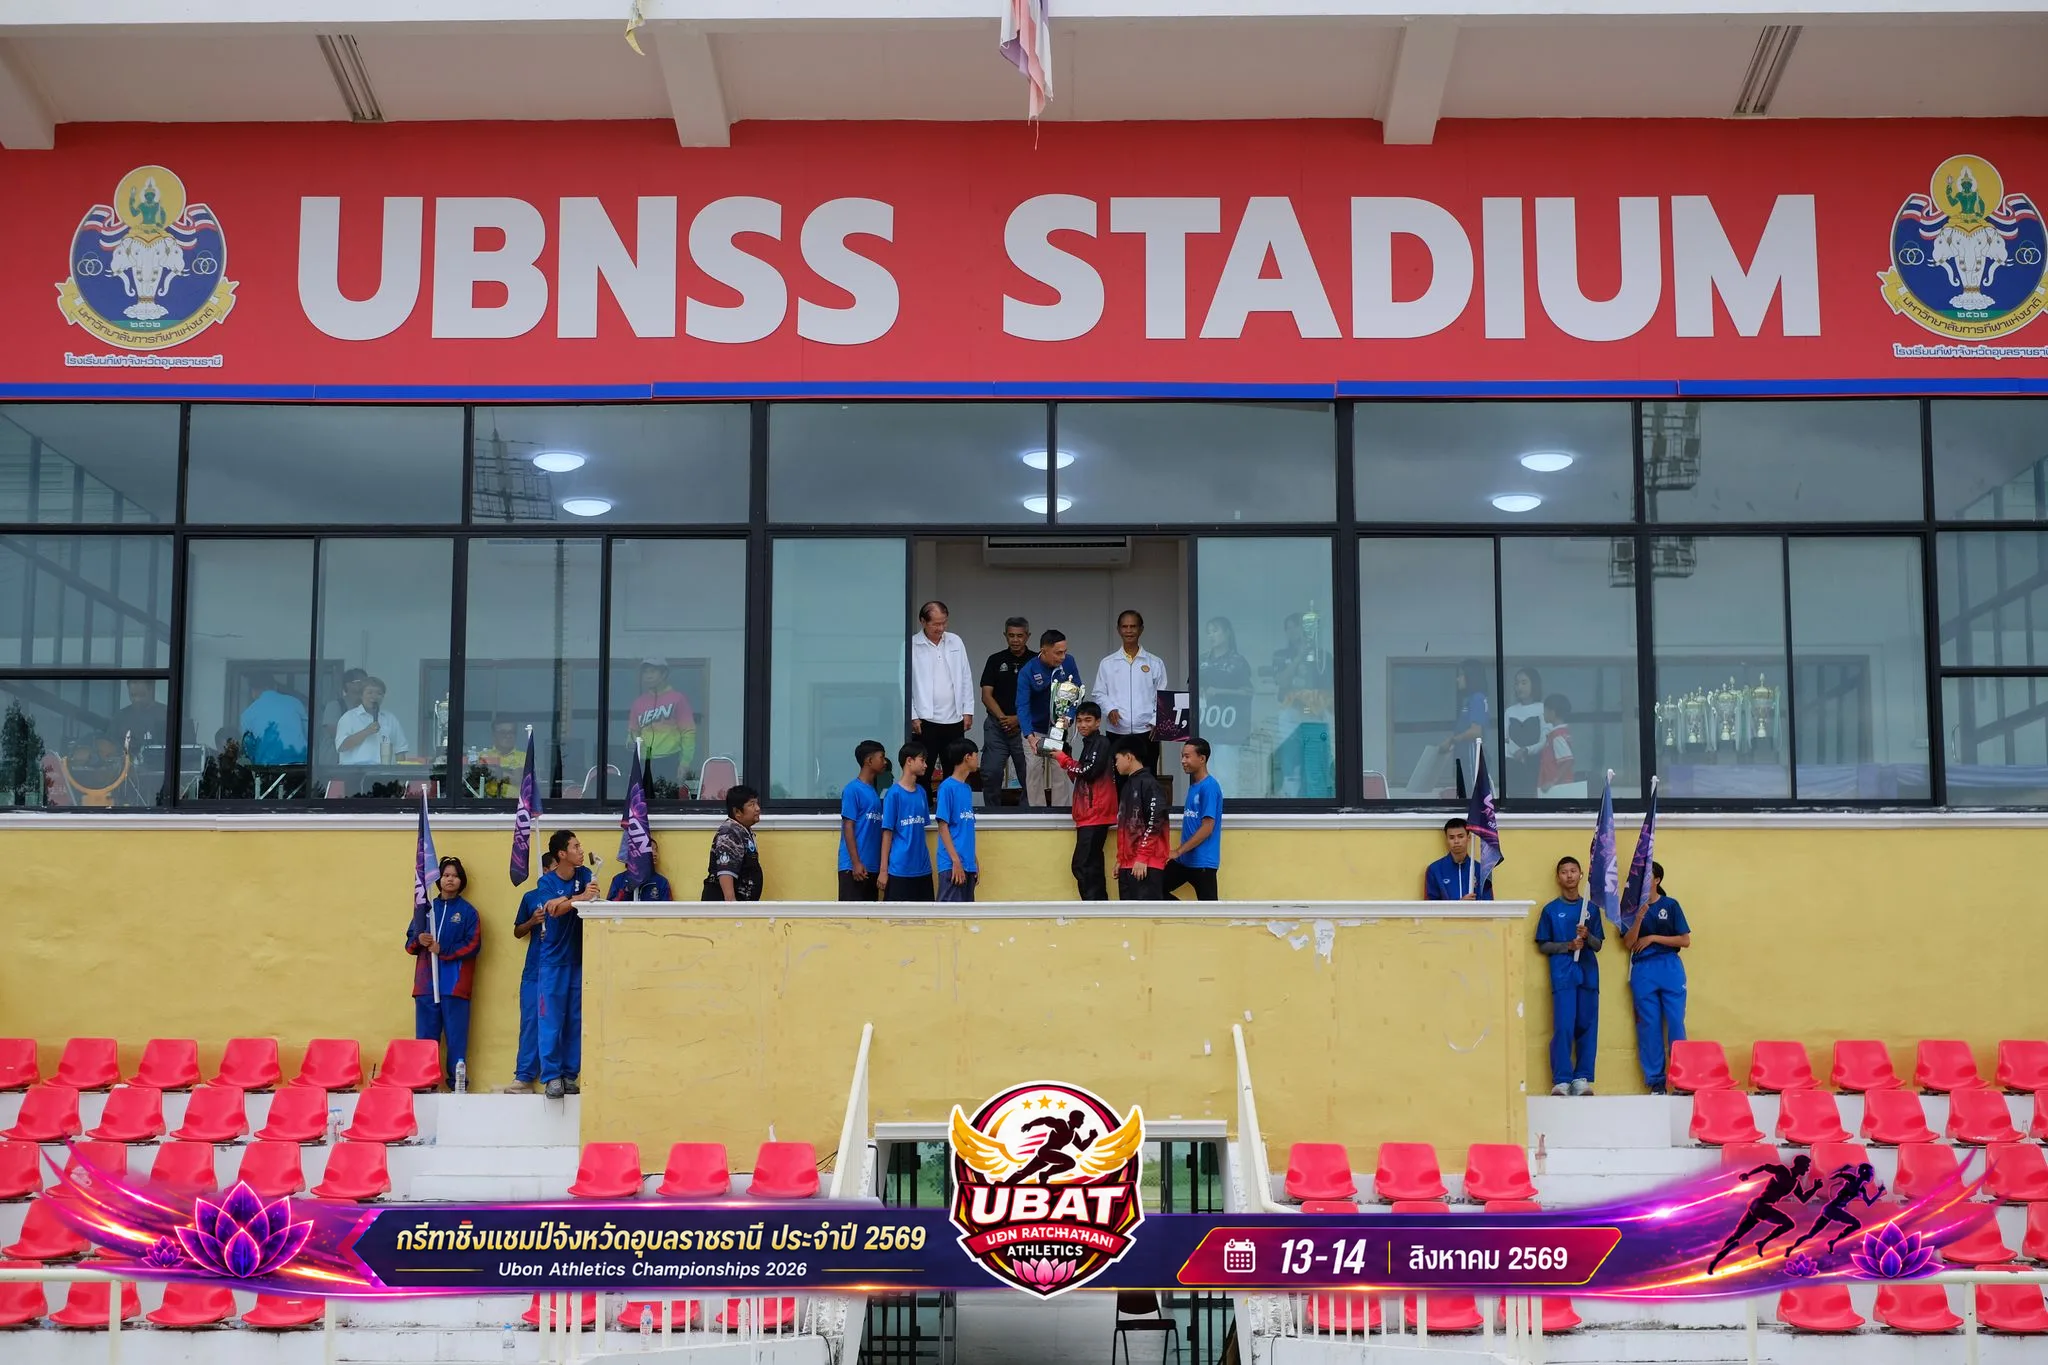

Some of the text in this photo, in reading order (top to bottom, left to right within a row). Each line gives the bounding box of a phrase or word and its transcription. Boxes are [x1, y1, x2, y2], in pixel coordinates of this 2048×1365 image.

[297, 193, 1821, 345] UBNSS STADIUM
[77, 306, 216, 345] มหาวิทยาลัยการกีฬาแห่งชาติ
[1901, 297, 2042, 334] มหาวิทยาลัยการกีฬาแห่งชาติ
[66, 354, 221, 368] โรงเรียนกีฬาจังหวัดอุบลราชธานี
